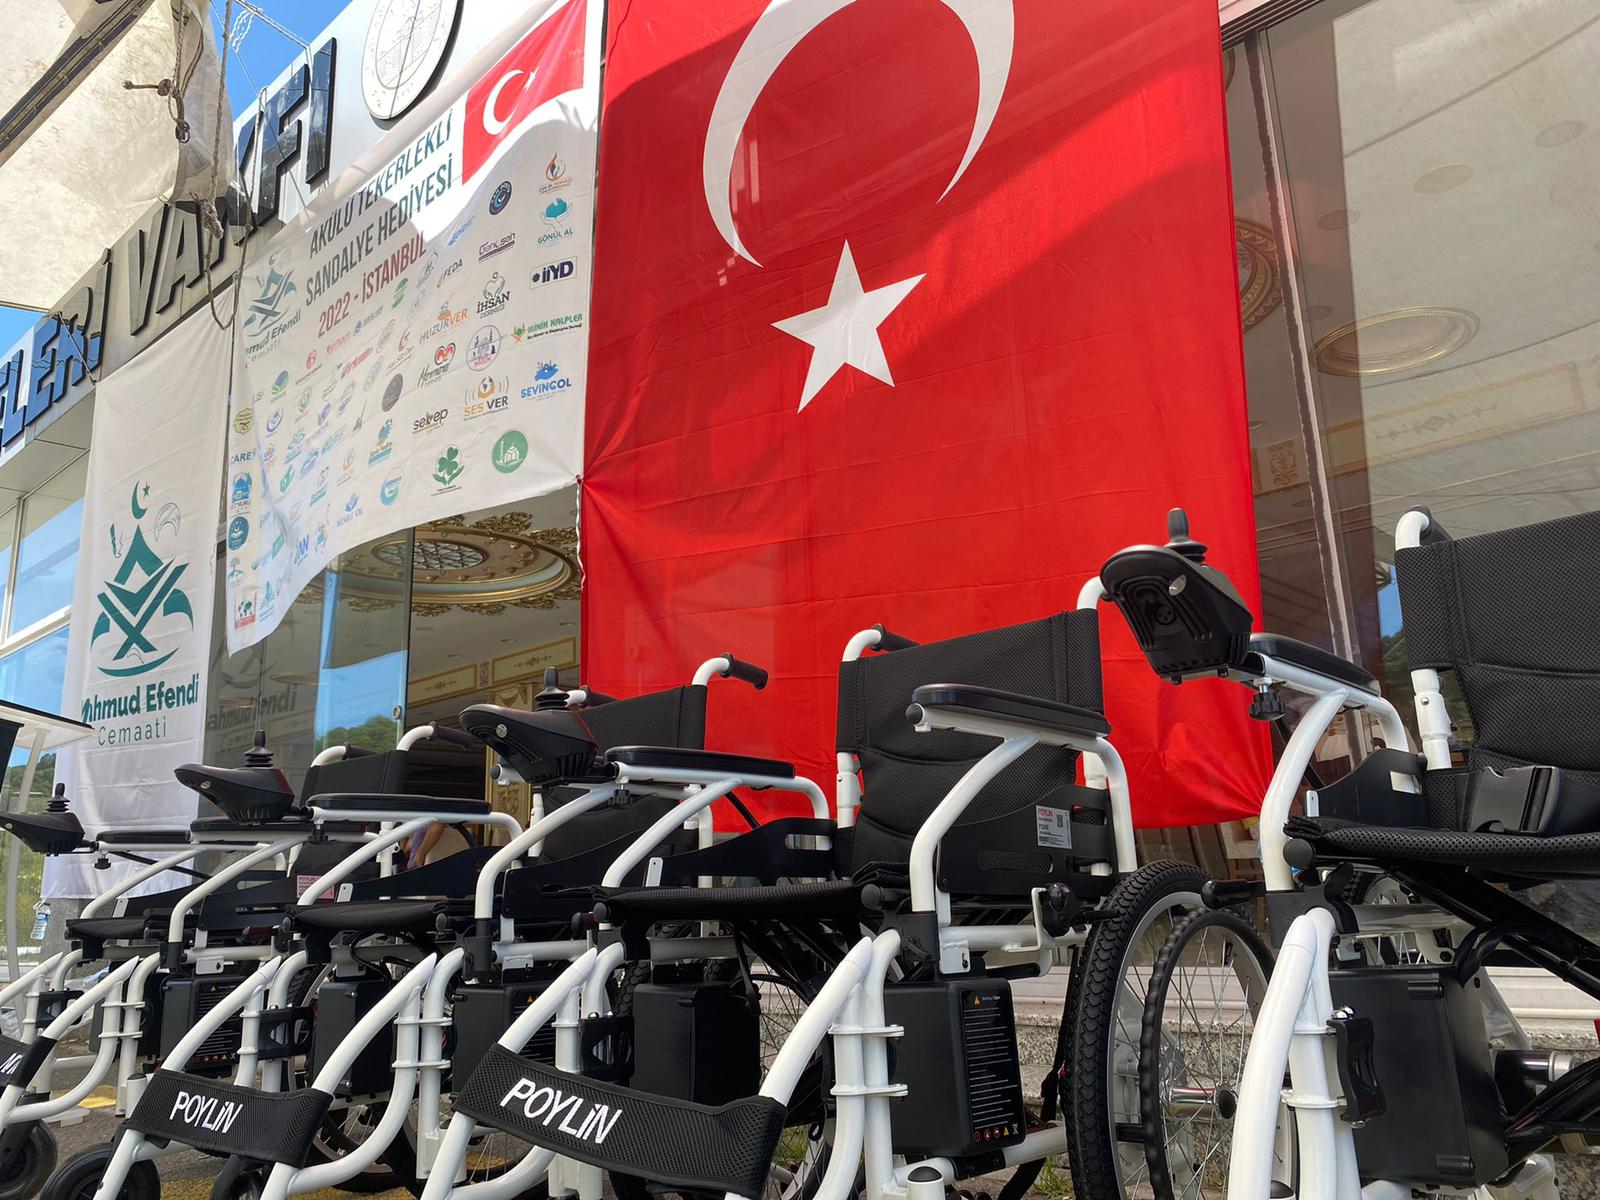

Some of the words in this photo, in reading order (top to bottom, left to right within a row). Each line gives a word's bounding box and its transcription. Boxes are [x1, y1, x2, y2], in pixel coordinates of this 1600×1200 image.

[358, 108, 453, 217] TEKERLEKLİ
[306, 223, 374, 306] SANDALYE
[378, 152, 453, 247] HEDİYESİ
[318, 291, 350, 338] 2022
[362, 230, 427, 304] İSTANBUL
[477, 291, 511, 314] İHSAN
[550, 313, 583, 326] KALPLER
[0, 248, 112, 447] LERİ
[464, 402, 484, 417] SES
[486, 396, 508, 410] VER
[146, 672, 199, 712] Efendi
[98, 716, 167, 746] Cemaati
